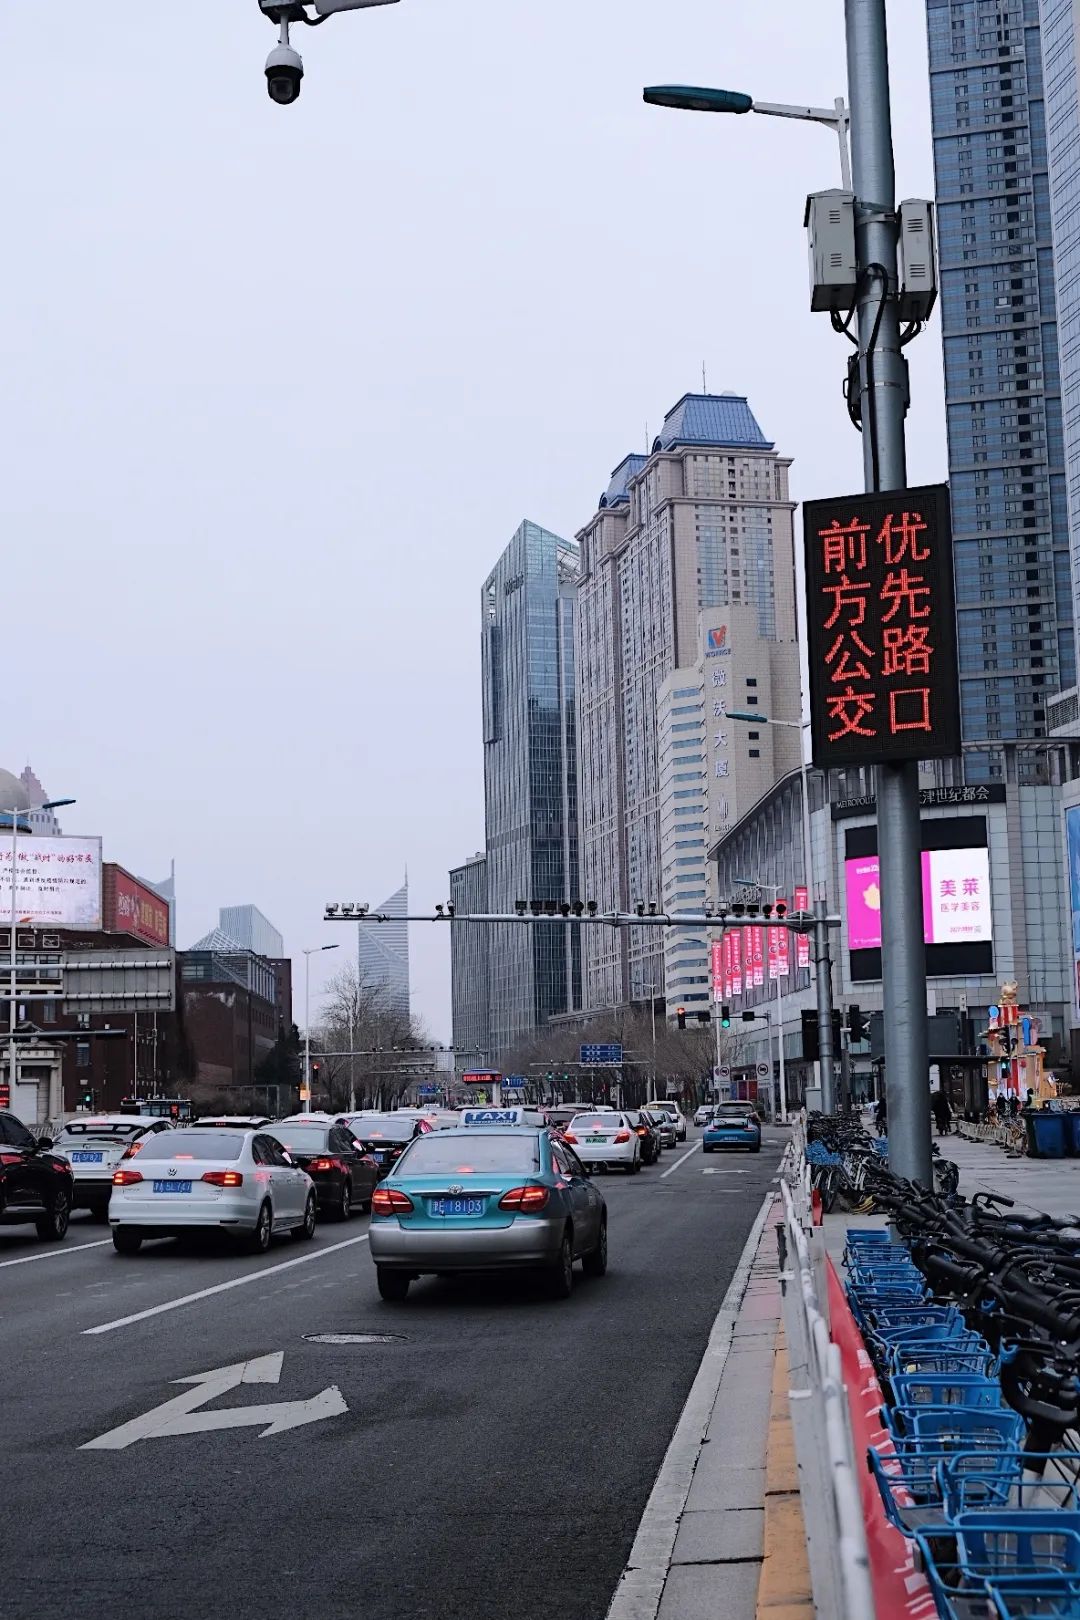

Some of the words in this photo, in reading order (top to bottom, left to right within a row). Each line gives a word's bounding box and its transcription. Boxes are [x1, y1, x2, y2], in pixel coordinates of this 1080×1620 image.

[818, 516, 877, 742] 前方公交
[876, 511, 934, 734] 优先路口
[919, 786, 989, 804] 津世纪都会
[940, 878, 980, 897] 美莱
[470, 1112, 514, 1120] TAXI
